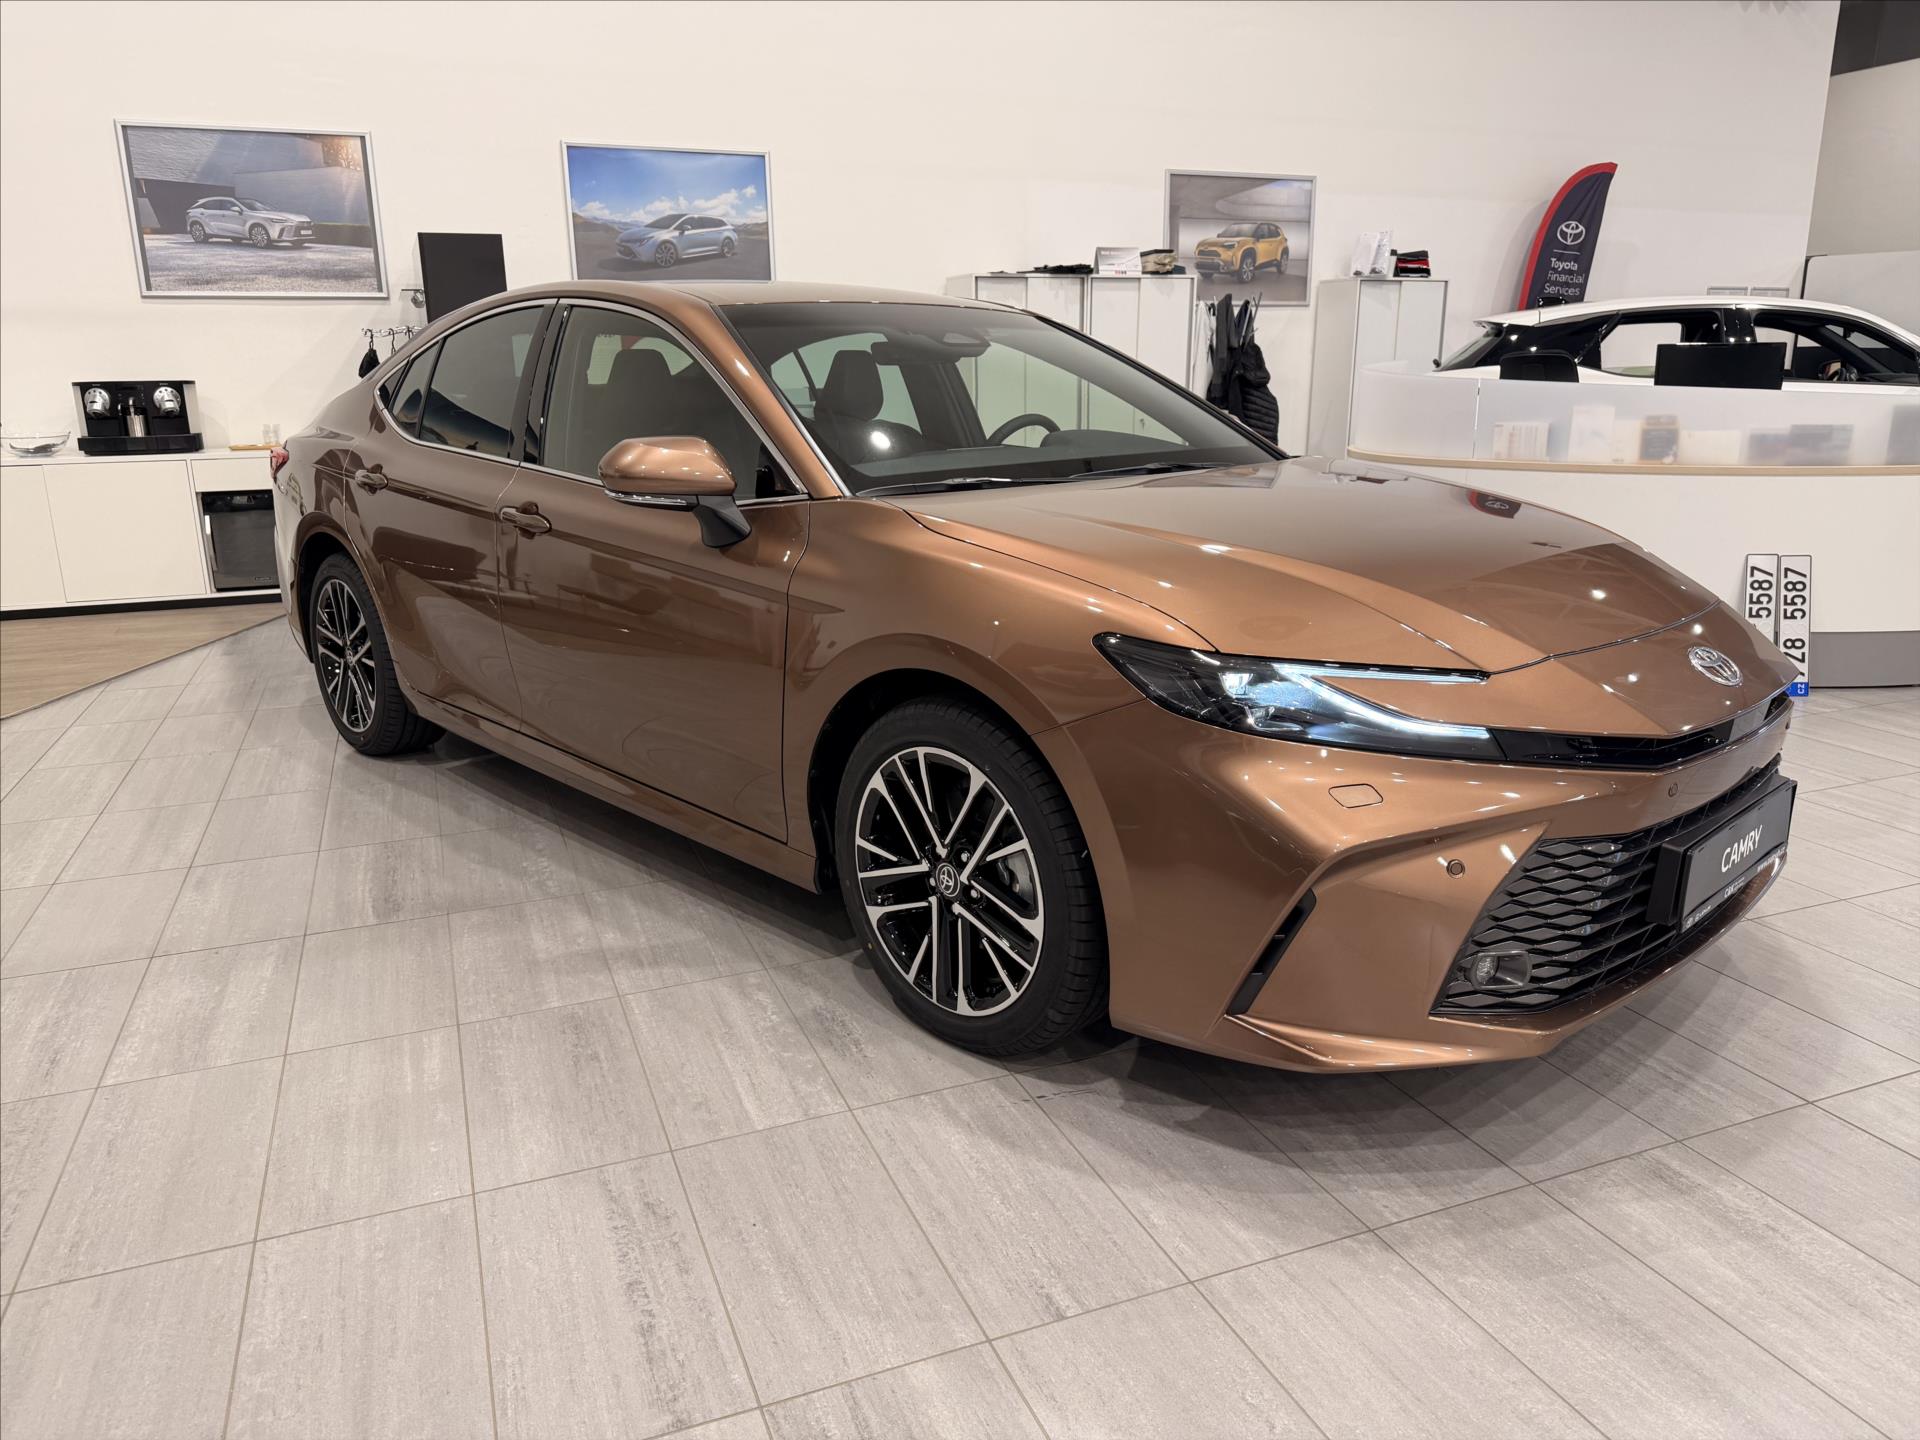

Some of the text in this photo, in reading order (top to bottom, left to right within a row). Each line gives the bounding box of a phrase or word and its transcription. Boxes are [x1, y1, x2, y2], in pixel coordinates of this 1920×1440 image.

[1547, 270, 1586, 284] Financial
[1550, 257, 1578, 271] Toyota
[1543, 282, 1581, 296] Services
[1748, 565, 1774, 619] 5587
[1782, 566, 1807, 694] CZ Z8 5587
[1721, 824, 1763, 873] CAMRY
